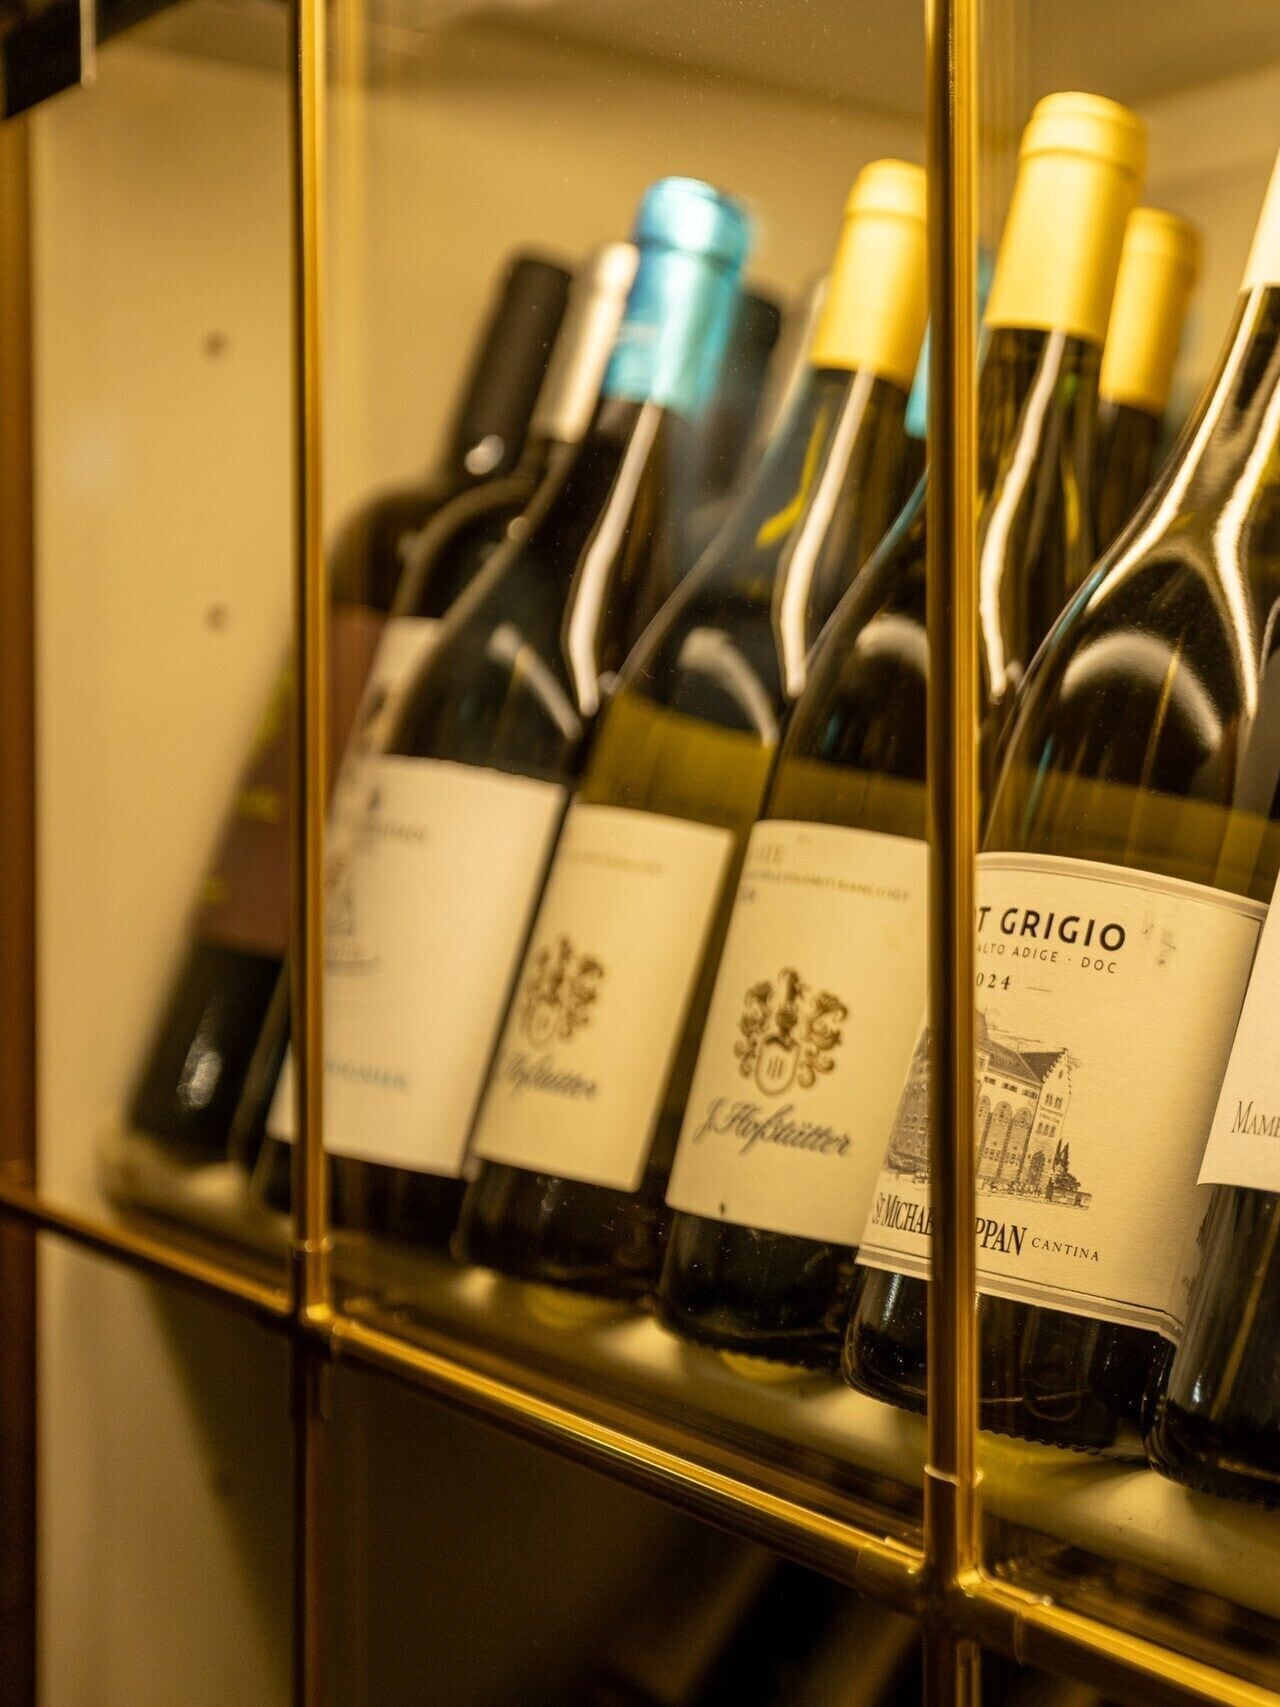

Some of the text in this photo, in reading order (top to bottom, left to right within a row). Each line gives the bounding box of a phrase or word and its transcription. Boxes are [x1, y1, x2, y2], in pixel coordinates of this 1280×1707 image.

[1000, 907, 1126, 951] GRIGIO
[1012, 946, 1058, 963] ADIGE
[1081, 956, 1117, 974] DOC
[975, 972, 1011, 990] 024
[975, 1217, 1027, 1256] PPAN
[1031, 1237, 1099, 1262] CANTINA
